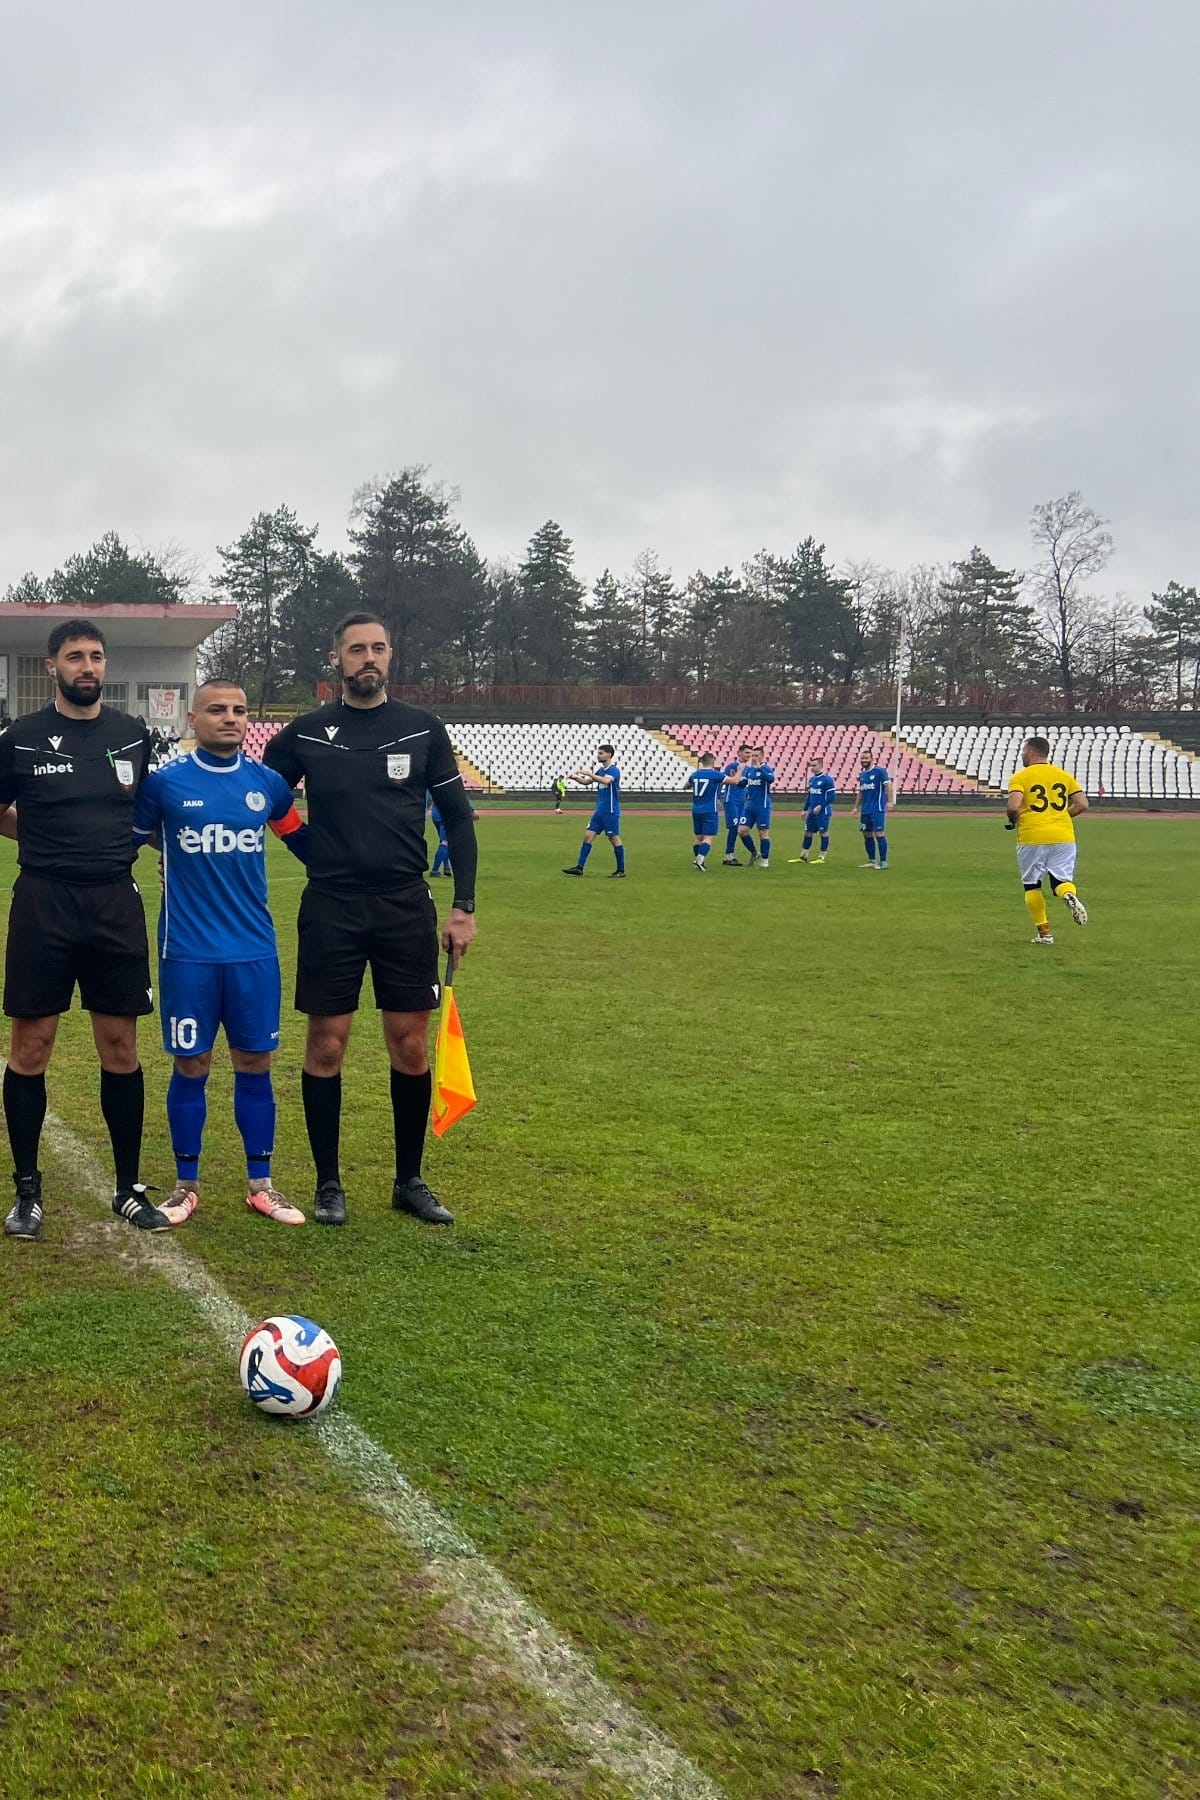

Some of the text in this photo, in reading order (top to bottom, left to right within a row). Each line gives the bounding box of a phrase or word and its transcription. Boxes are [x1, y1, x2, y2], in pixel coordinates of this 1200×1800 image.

[33, 762, 74, 776] inbet
[693, 778, 710, 797] 17
[1030, 783, 1067, 813] 33
[182, 800, 204, 808] JAKO
[178, 823, 264, 854] efbet
[170, 1016, 198, 1050] 10
